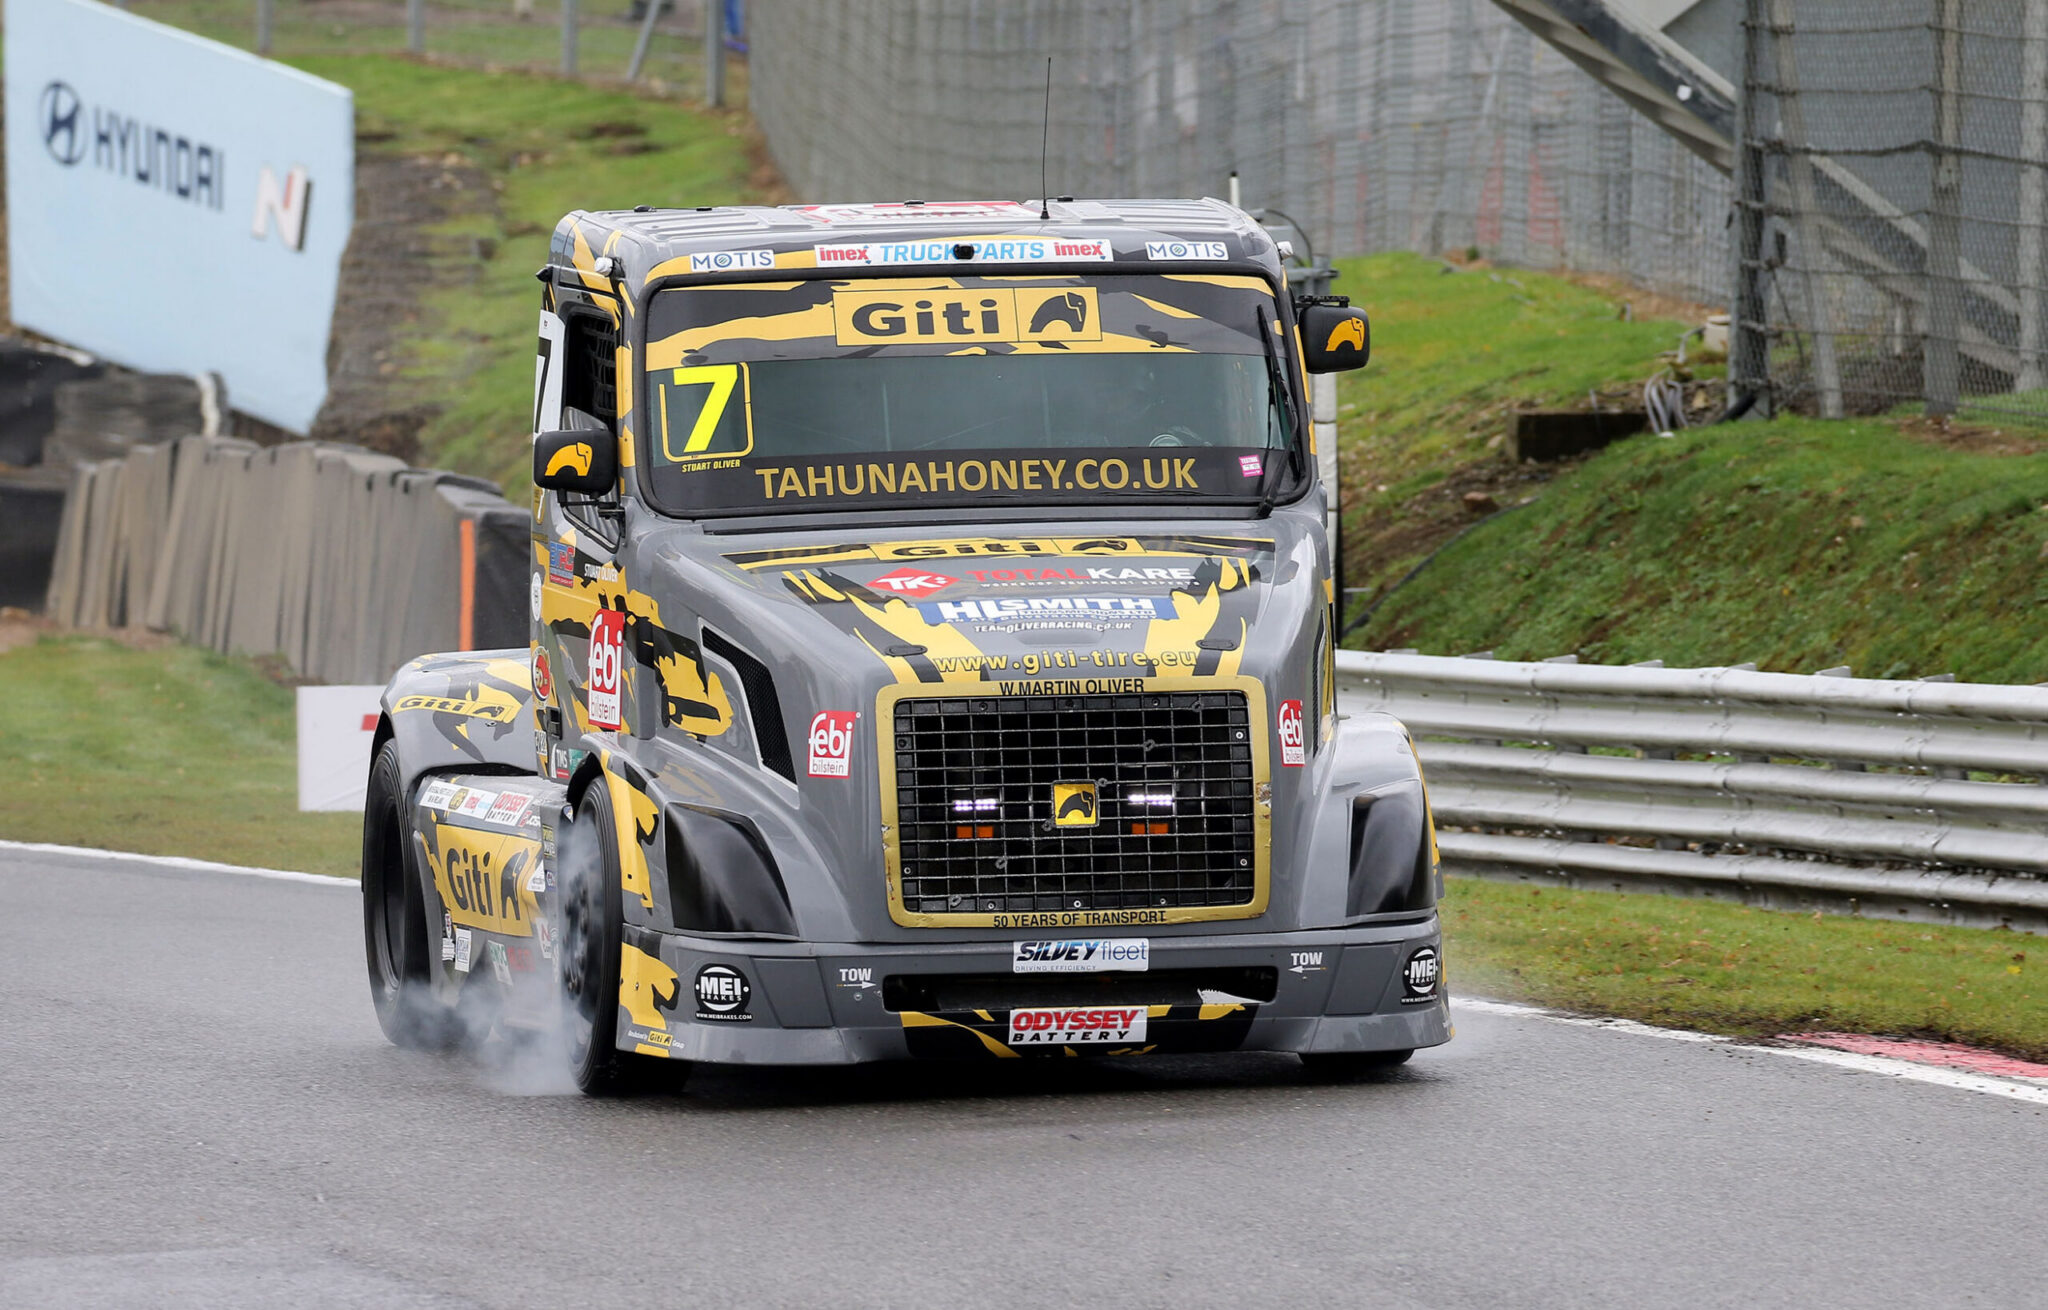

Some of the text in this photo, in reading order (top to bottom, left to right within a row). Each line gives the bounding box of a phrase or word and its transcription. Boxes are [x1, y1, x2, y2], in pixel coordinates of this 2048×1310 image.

[95, 105, 224, 213] HYUNDAI
[251, 163, 313, 252] N
[692, 251, 772, 270] MOTIS
[819, 241, 1103, 263] imex TRUCK PARTS imex
[1149, 243, 1226, 259] MOTIS
[851, 298, 1000, 337] Giti
[673, 364, 738, 453] 7
[681, 459, 741, 473] STUART OLIVER
[755, 458, 1199, 499] TAHUNAHONEY.CO.UK
[892, 541, 1041, 557] Giti
[588, 613, 623, 693] febi
[935, 648, 1197, 674] www.giti-tire.eu
[1000, 679, 1144, 696] W.MARTIN OLIVER
[400, 697, 466, 711] Giti
[591, 695, 616, 721] bilstein
[1279, 702, 1303, 746] febi
[808, 713, 854, 757] febi
[812, 760, 845, 774] bilstein
[493, 793, 530, 813] ODYSSEY
[487, 810, 517, 825] BATTERY
[447, 848, 494, 917] Giti
[994, 910, 1167, 927] 50 YEARS OF TRANSPORT
[1016, 941, 1147, 961] SILVEY fleet
[1291, 952, 1323, 966] TOW
[839, 968, 872, 982] TOW
[1410, 957, 1436, 979] MEI
[700, 976, 742, 996] MEI
[700, 994, 742, 1002] BRAKES
[696, 1012, 753, 1020] WWW.MEIBRAKES.COM
[1012, 1010, 1138, 1031] ODYSSEY
[1012, 1031, 1129, 1042] BATTERY
